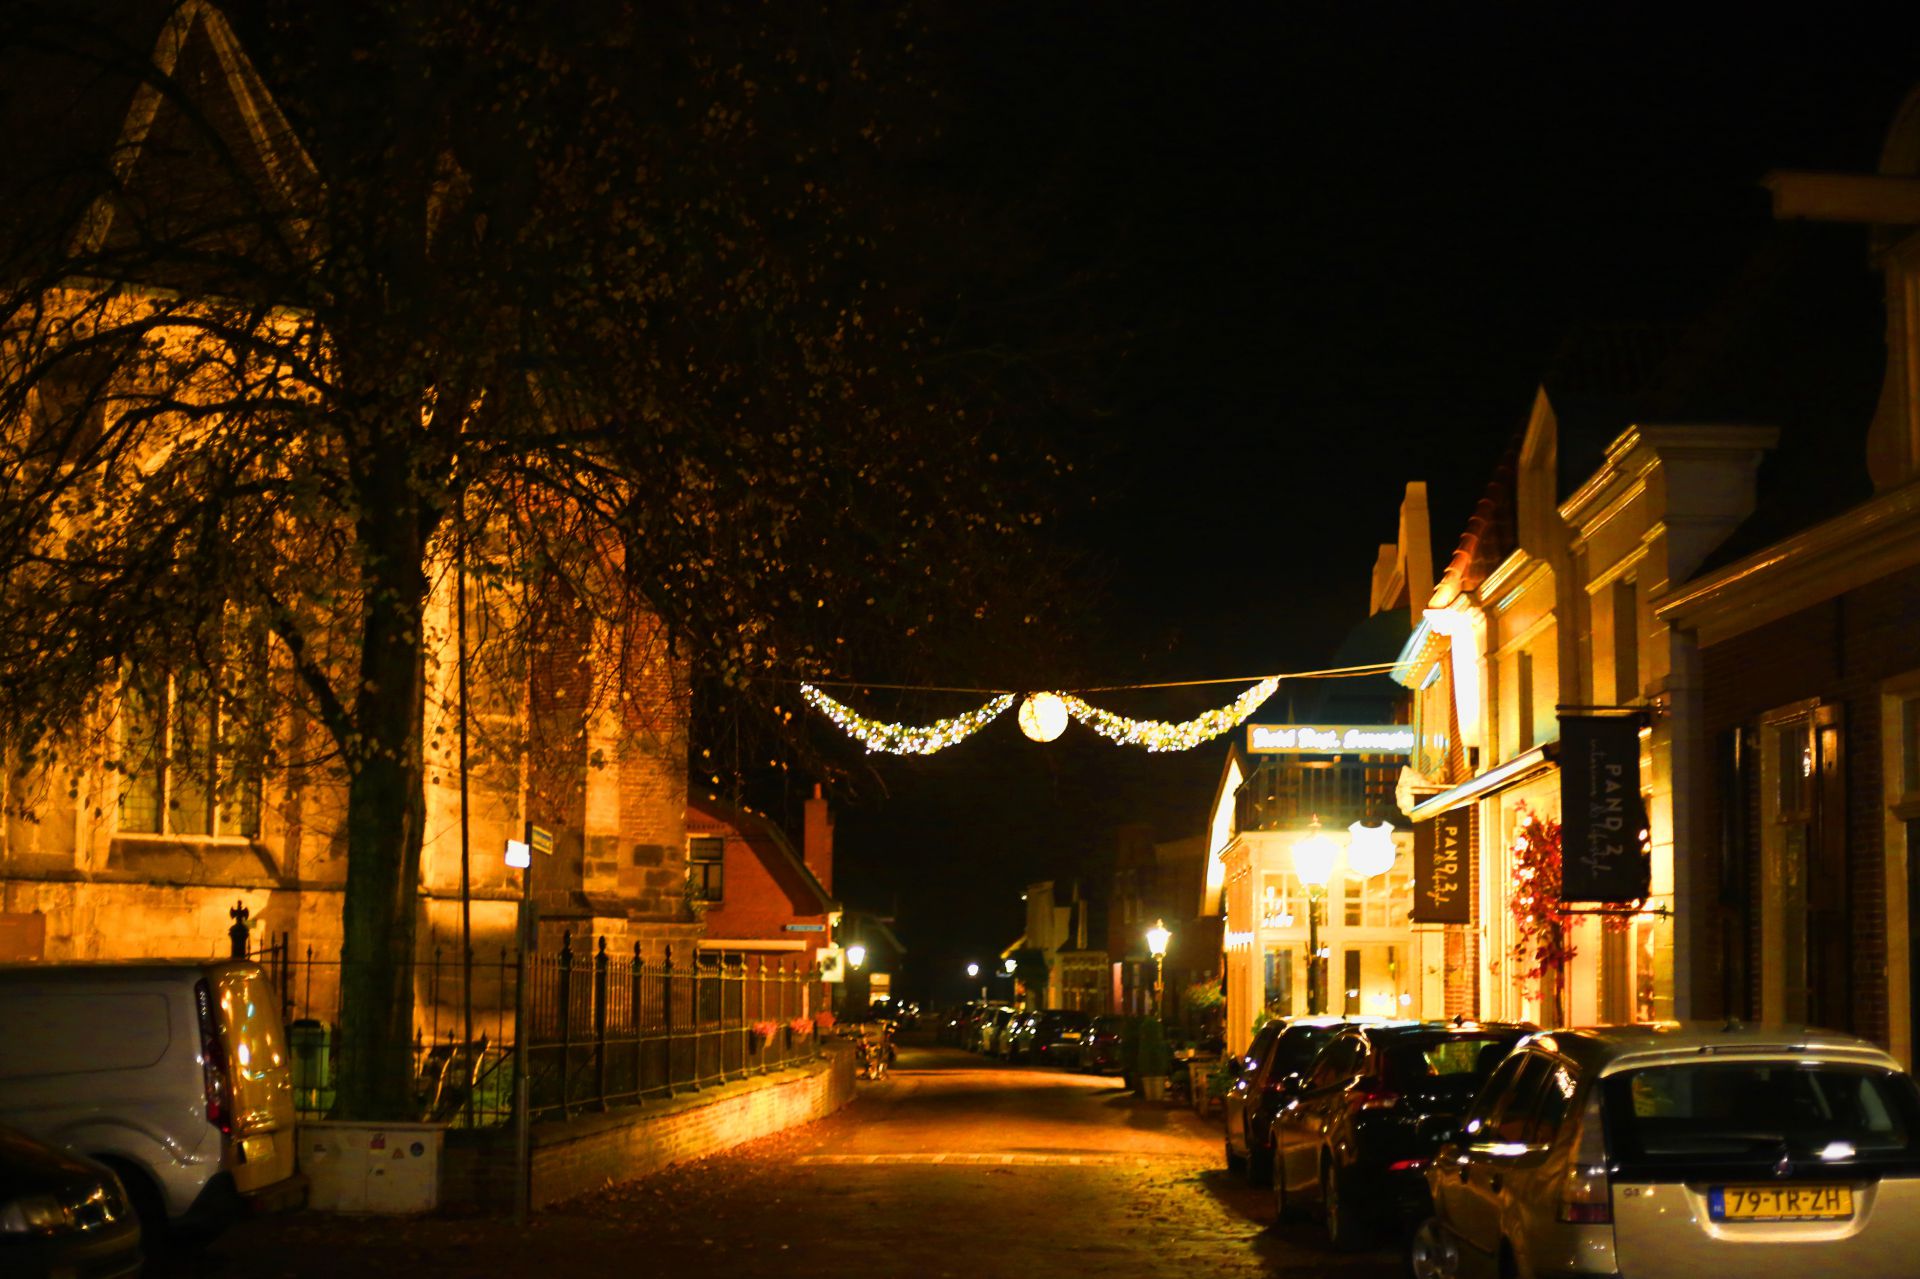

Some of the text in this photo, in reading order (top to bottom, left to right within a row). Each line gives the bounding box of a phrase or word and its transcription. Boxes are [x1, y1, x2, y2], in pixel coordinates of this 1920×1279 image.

[1605, 764, 1623, 857] PAND 2
[1445, 826, 1458, 892] PAND 2
[1732, 1189, 1841, 1213] 79-TR-ZH
